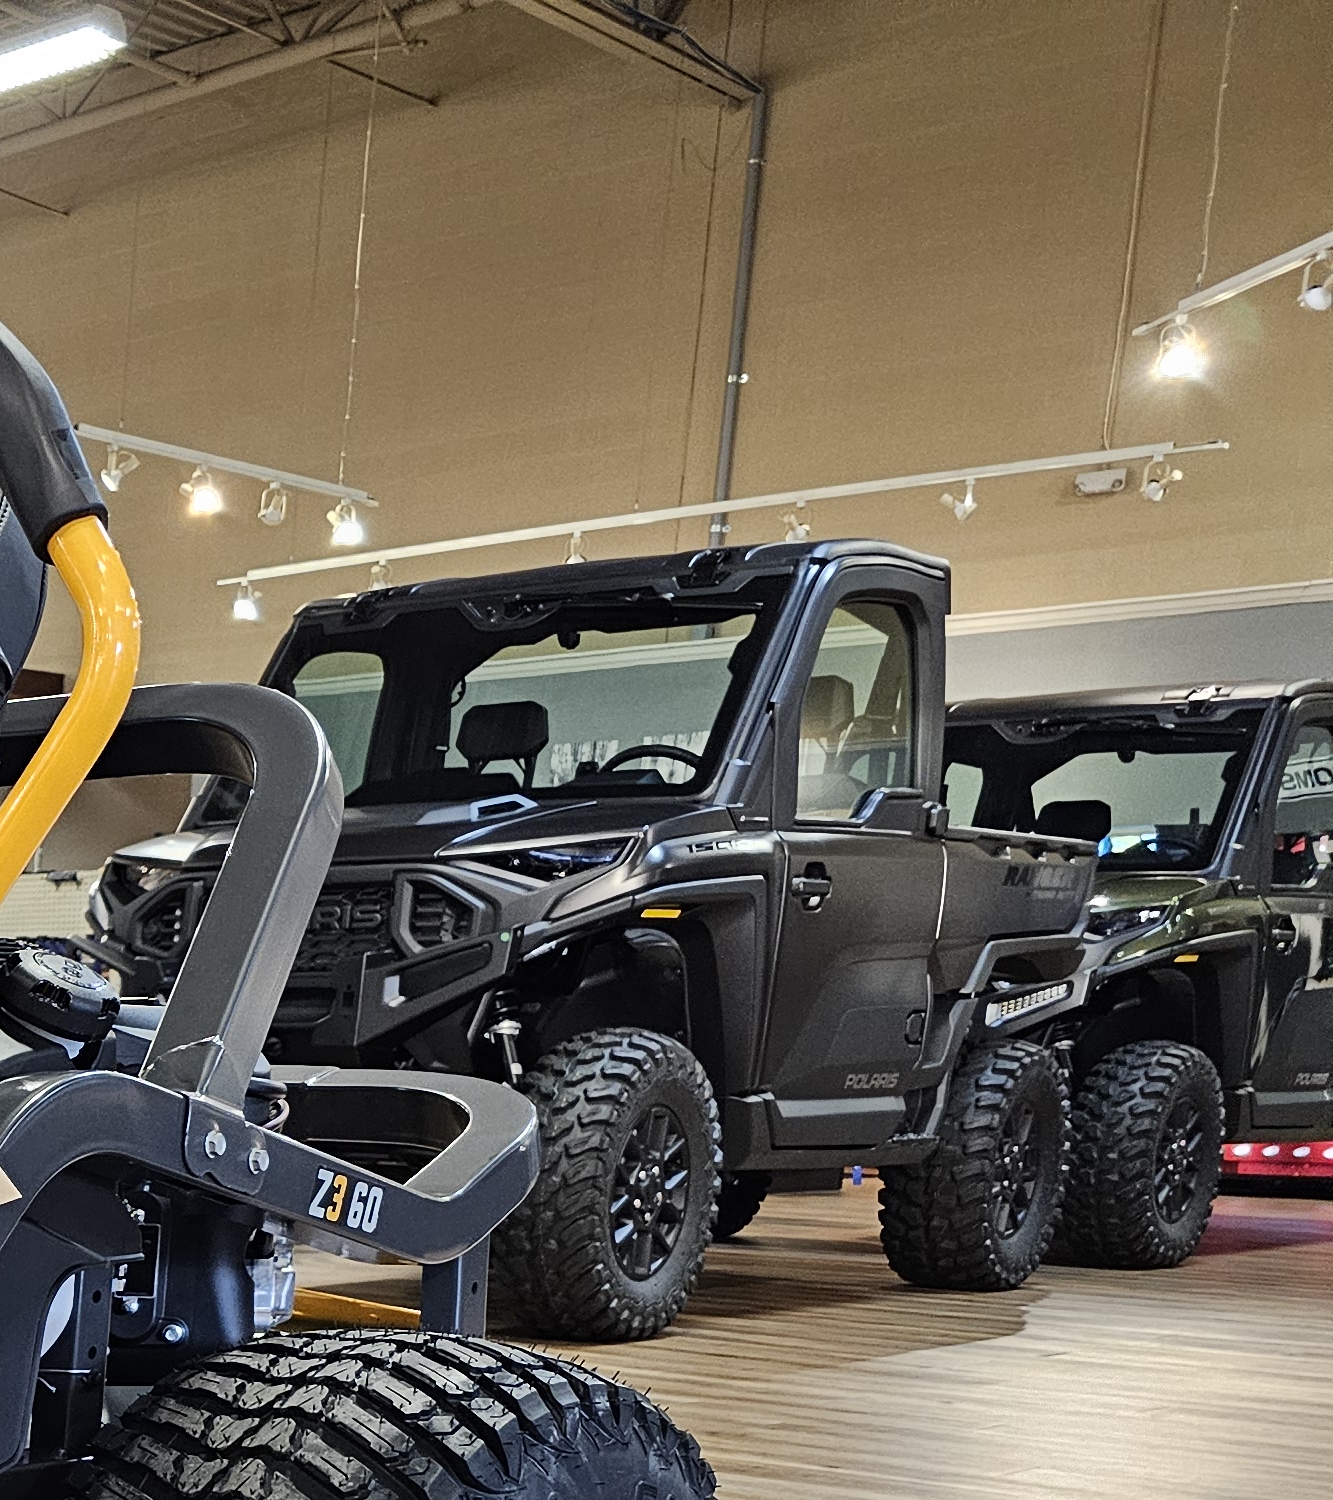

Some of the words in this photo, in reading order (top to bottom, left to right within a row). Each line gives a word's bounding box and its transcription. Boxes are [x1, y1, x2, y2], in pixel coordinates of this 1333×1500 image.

[844, 1072, 899, 1089] POLARIS
[308, 1168, 348, 1222] Z3
[346, 1181, 384, 1234] 60
